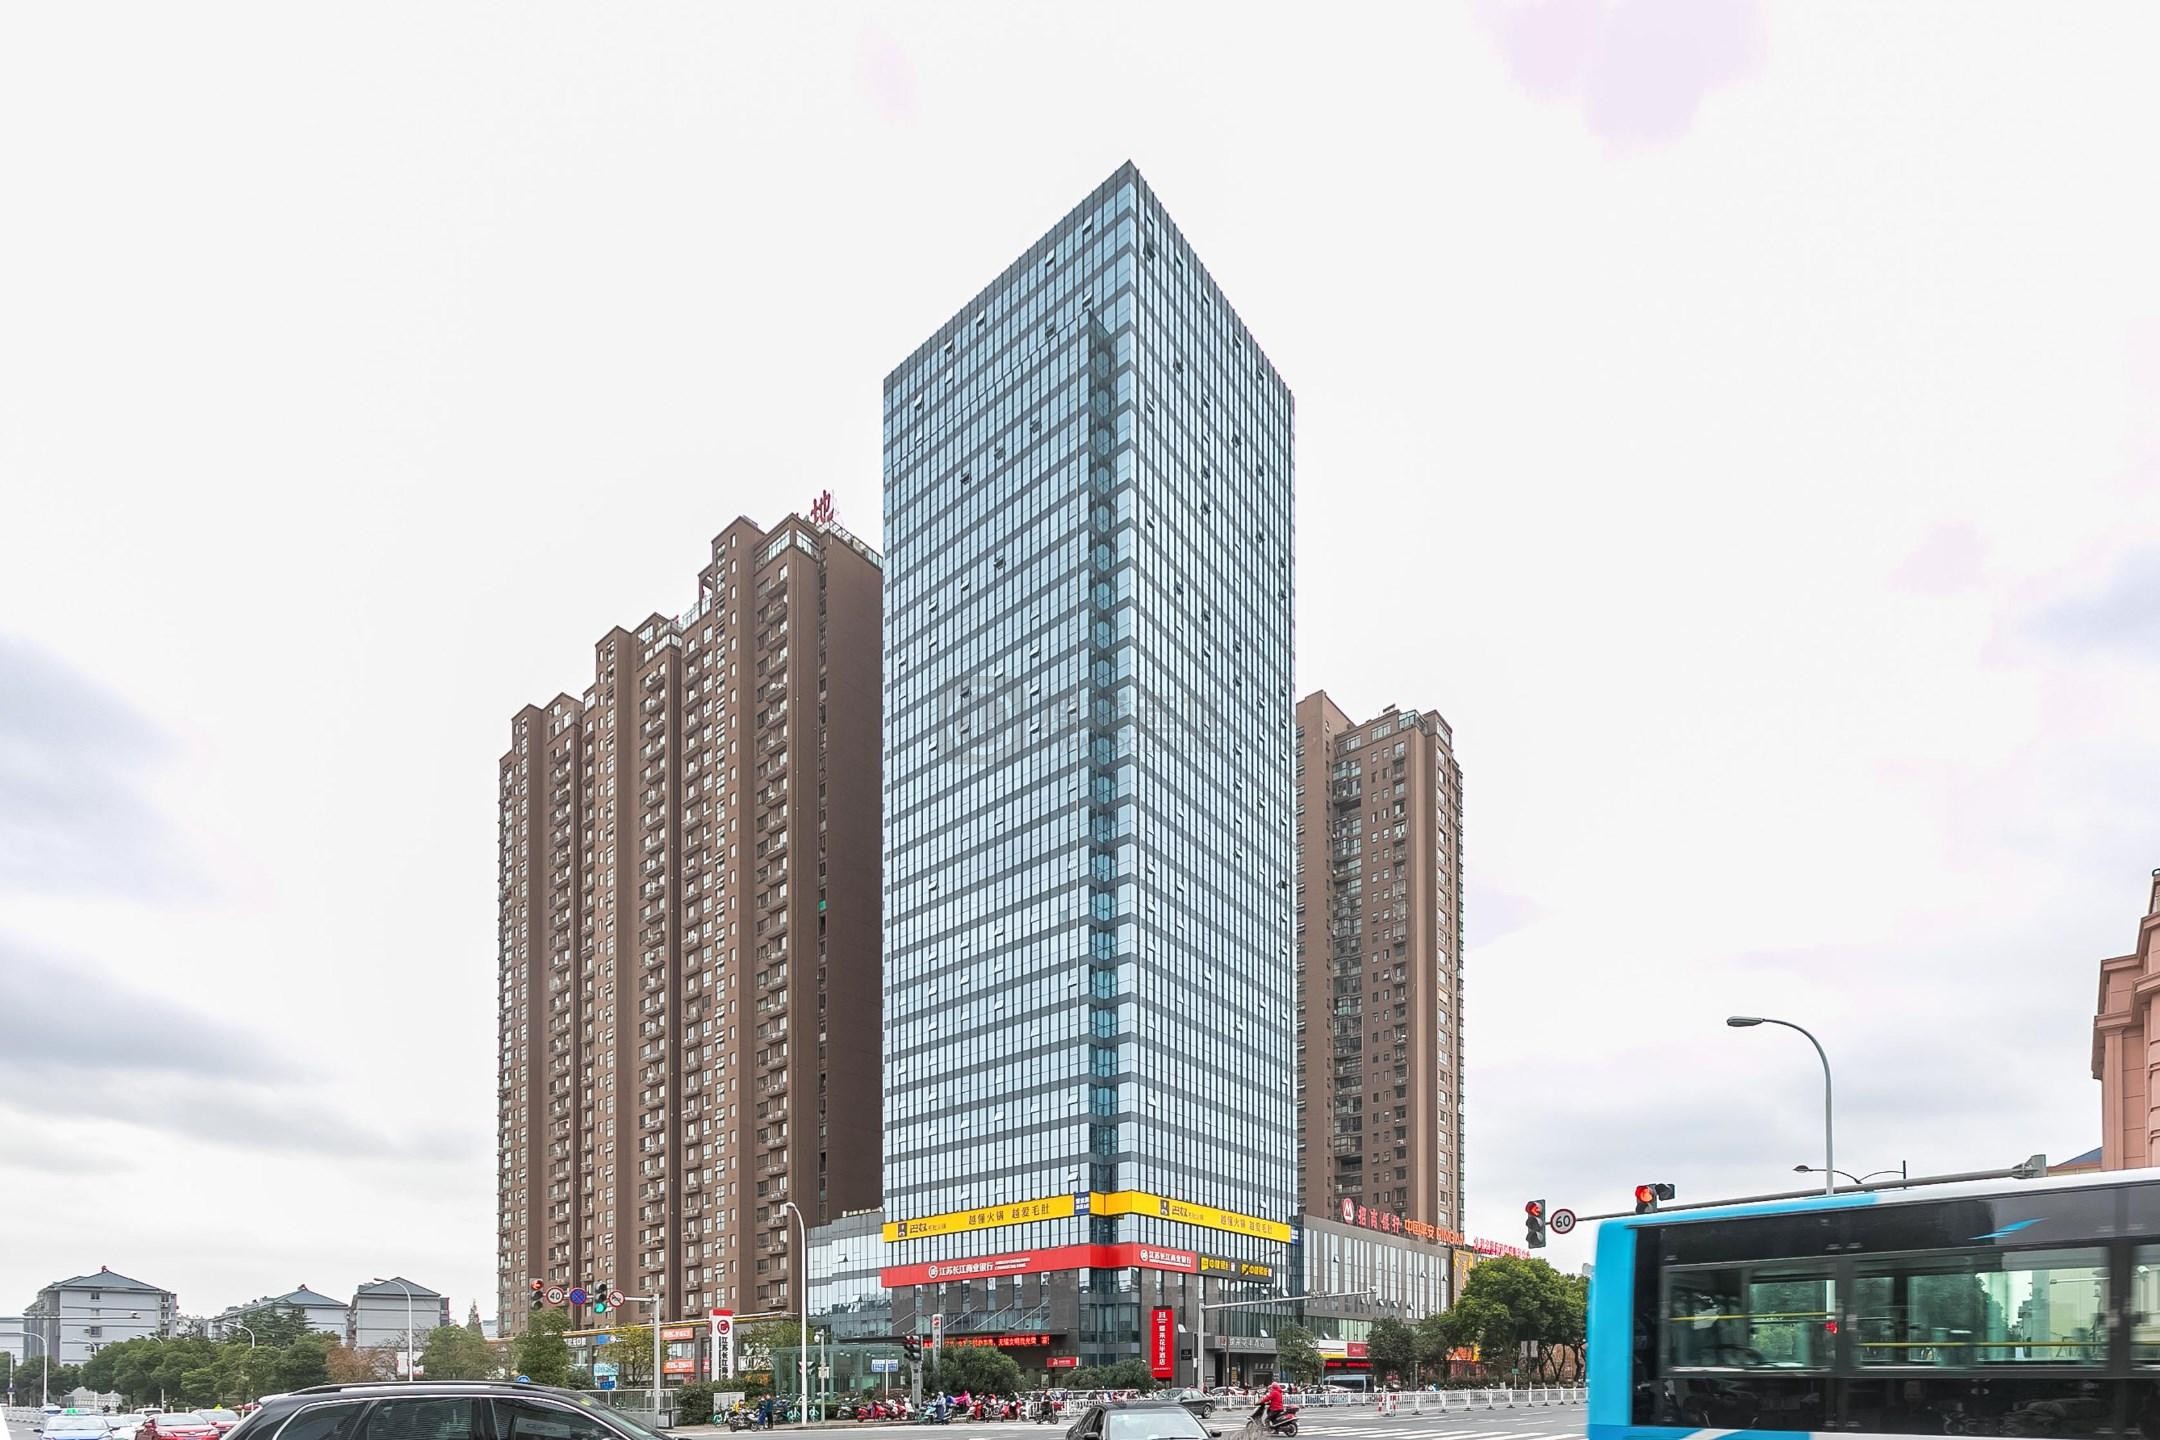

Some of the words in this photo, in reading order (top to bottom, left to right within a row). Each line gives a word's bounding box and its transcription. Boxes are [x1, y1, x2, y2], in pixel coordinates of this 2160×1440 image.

[968, 1212, 1005, 1226] 越懂火锅
[1011, 1204, 1050, 1219] 越爱毛肚
[1357, 1205, 1401, 1234] 招商银行
[1556, 1215, 1571, 1228] 60
[909, 1222, 928, 1234] 巴奴
[1220, 1215, 1246, 1229] 越懂火锅
[1249, 1220, 1273, 1235] 越爱毛肚
[1404, 1218, 1435, 1240] 中国平安
[1149, 1250, 1192, 1265] 江苏长江商业银行
[939, 1262, 993, 1276] 江苏长江商业银行
[549, 1292, 561, 1300] 40
